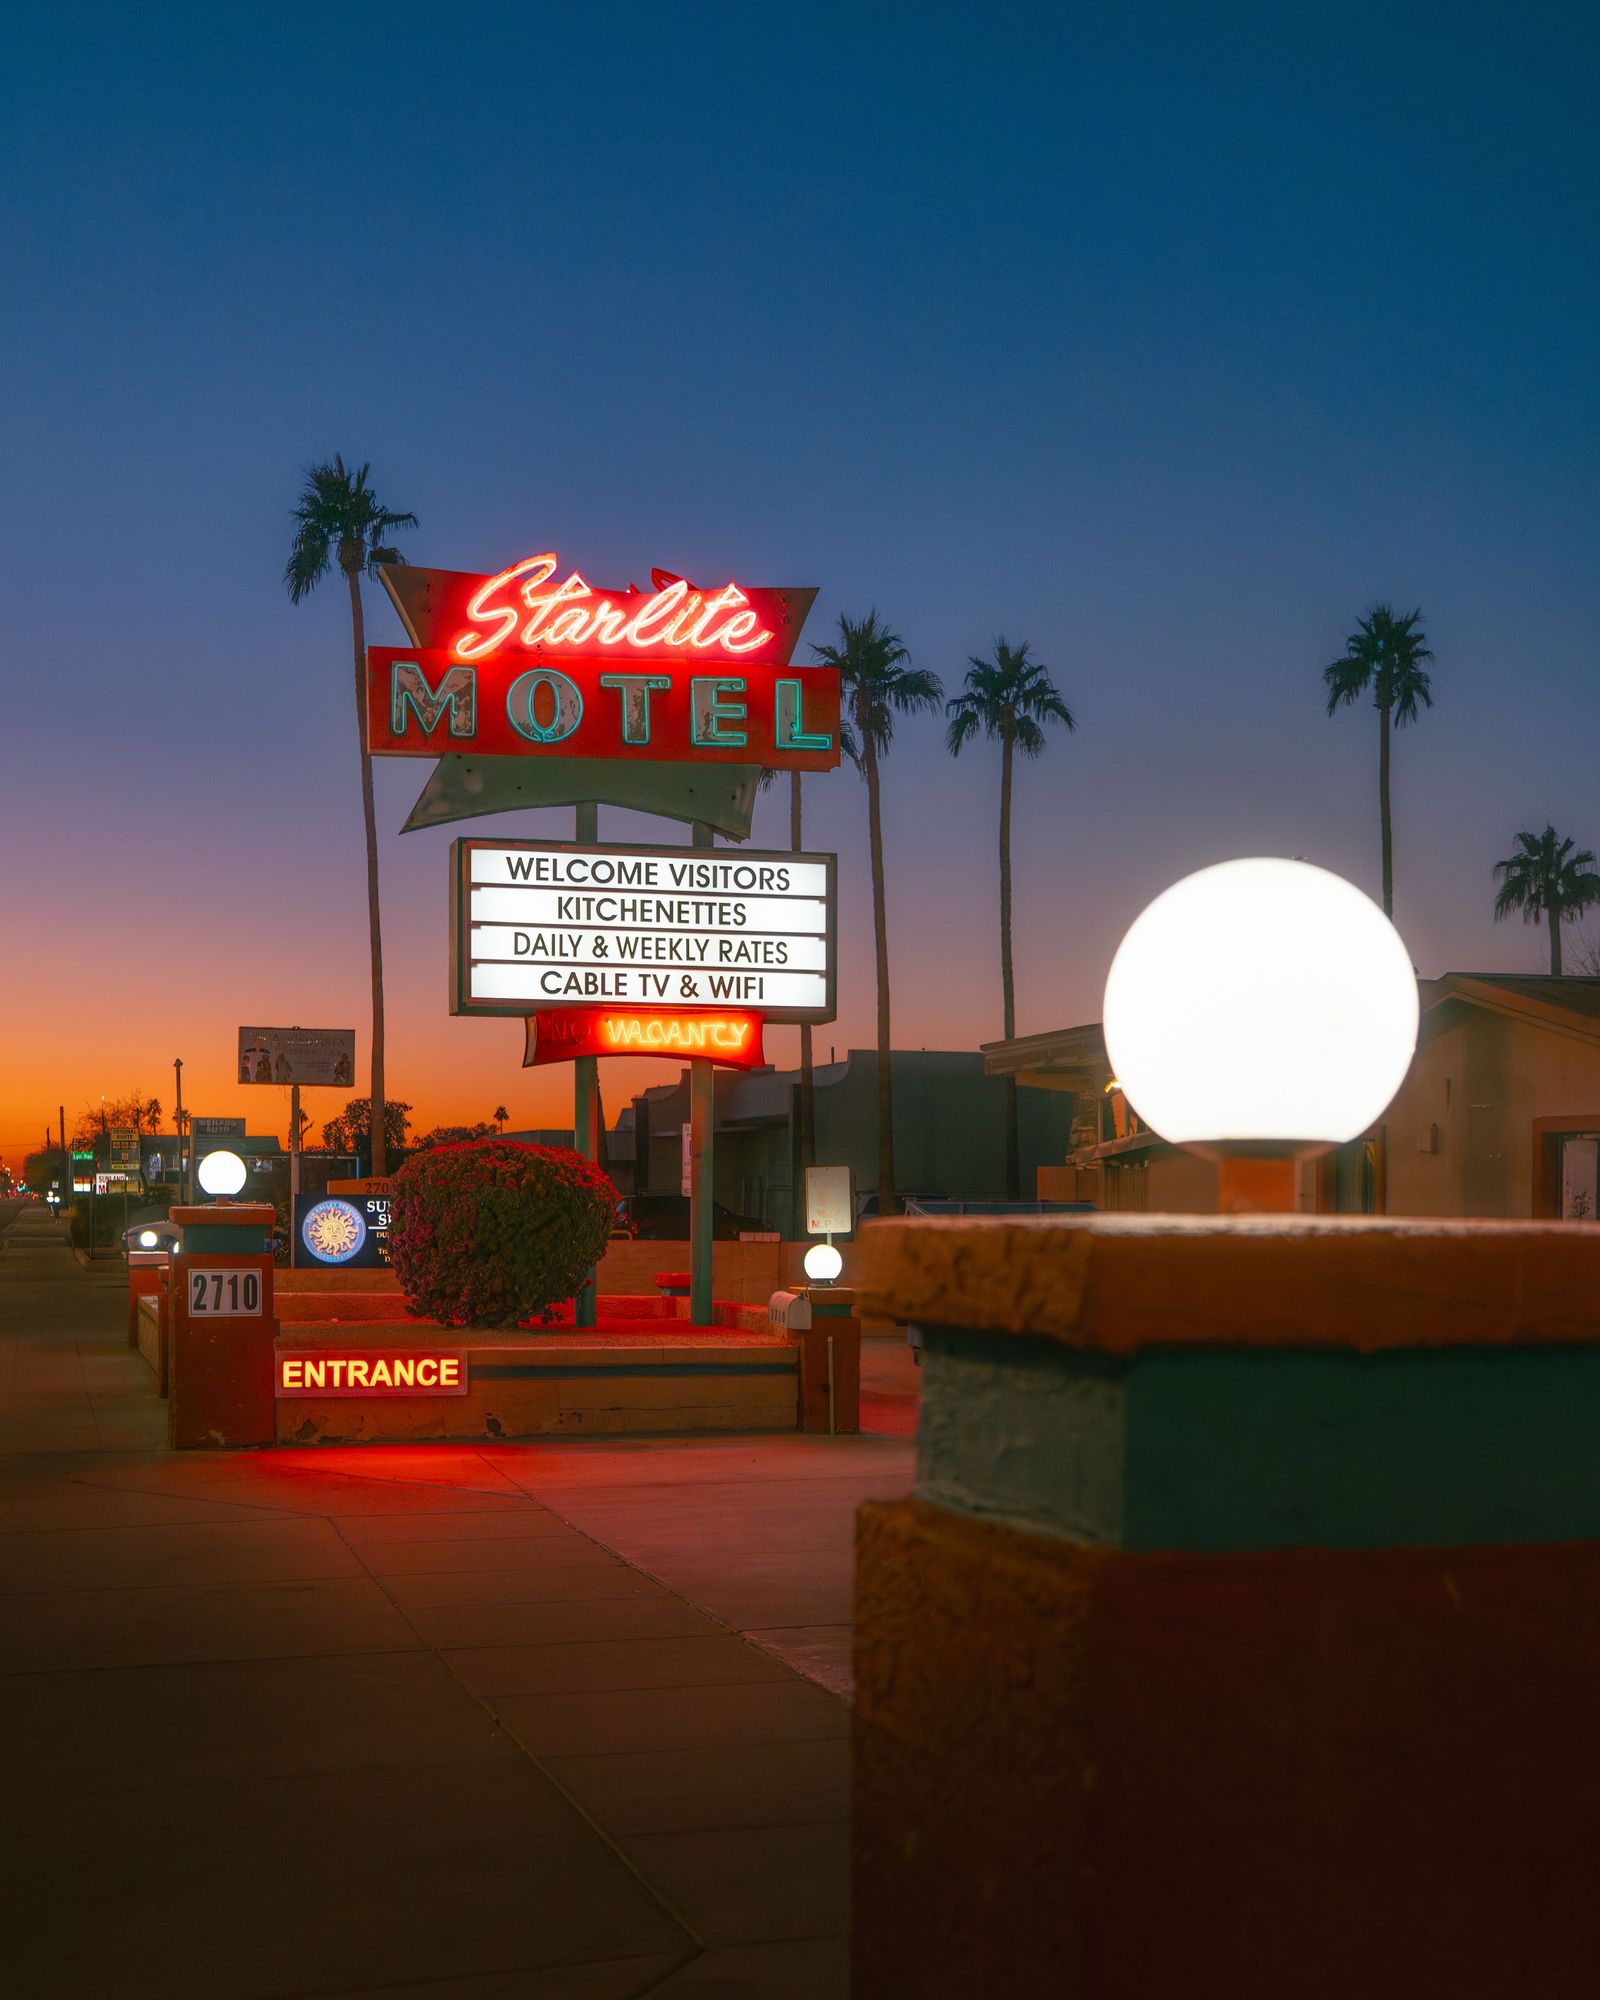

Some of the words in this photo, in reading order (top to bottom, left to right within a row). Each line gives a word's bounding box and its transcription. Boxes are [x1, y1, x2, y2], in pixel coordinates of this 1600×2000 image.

[456, 552, 774, 658] Starlite
[391, 660, 833, 750] MOTEL
[506, 856, 658, 886] WELCOME
[669, 863, 790, 891] VISITORS
[557, 896, 747, 926] KITCHENETTES
[513, 931, 583, 957] DAILY
[592, 936, 609, 958] &
[616, 936, 709, 962] WEEKLY
[719, 939, 788, 964] RATES
[540, 970, 627, 996] CABLE
[638, 974, 670, 996] TV
[680, 974, 699, 998] &
[708, 976, 764, 999] WIFI
[608, 1019, 748, 1046] VACANCY
[193, 1274, 258, 1310] 2710
[283, 1359, 459, 1388] ENTRANCE
